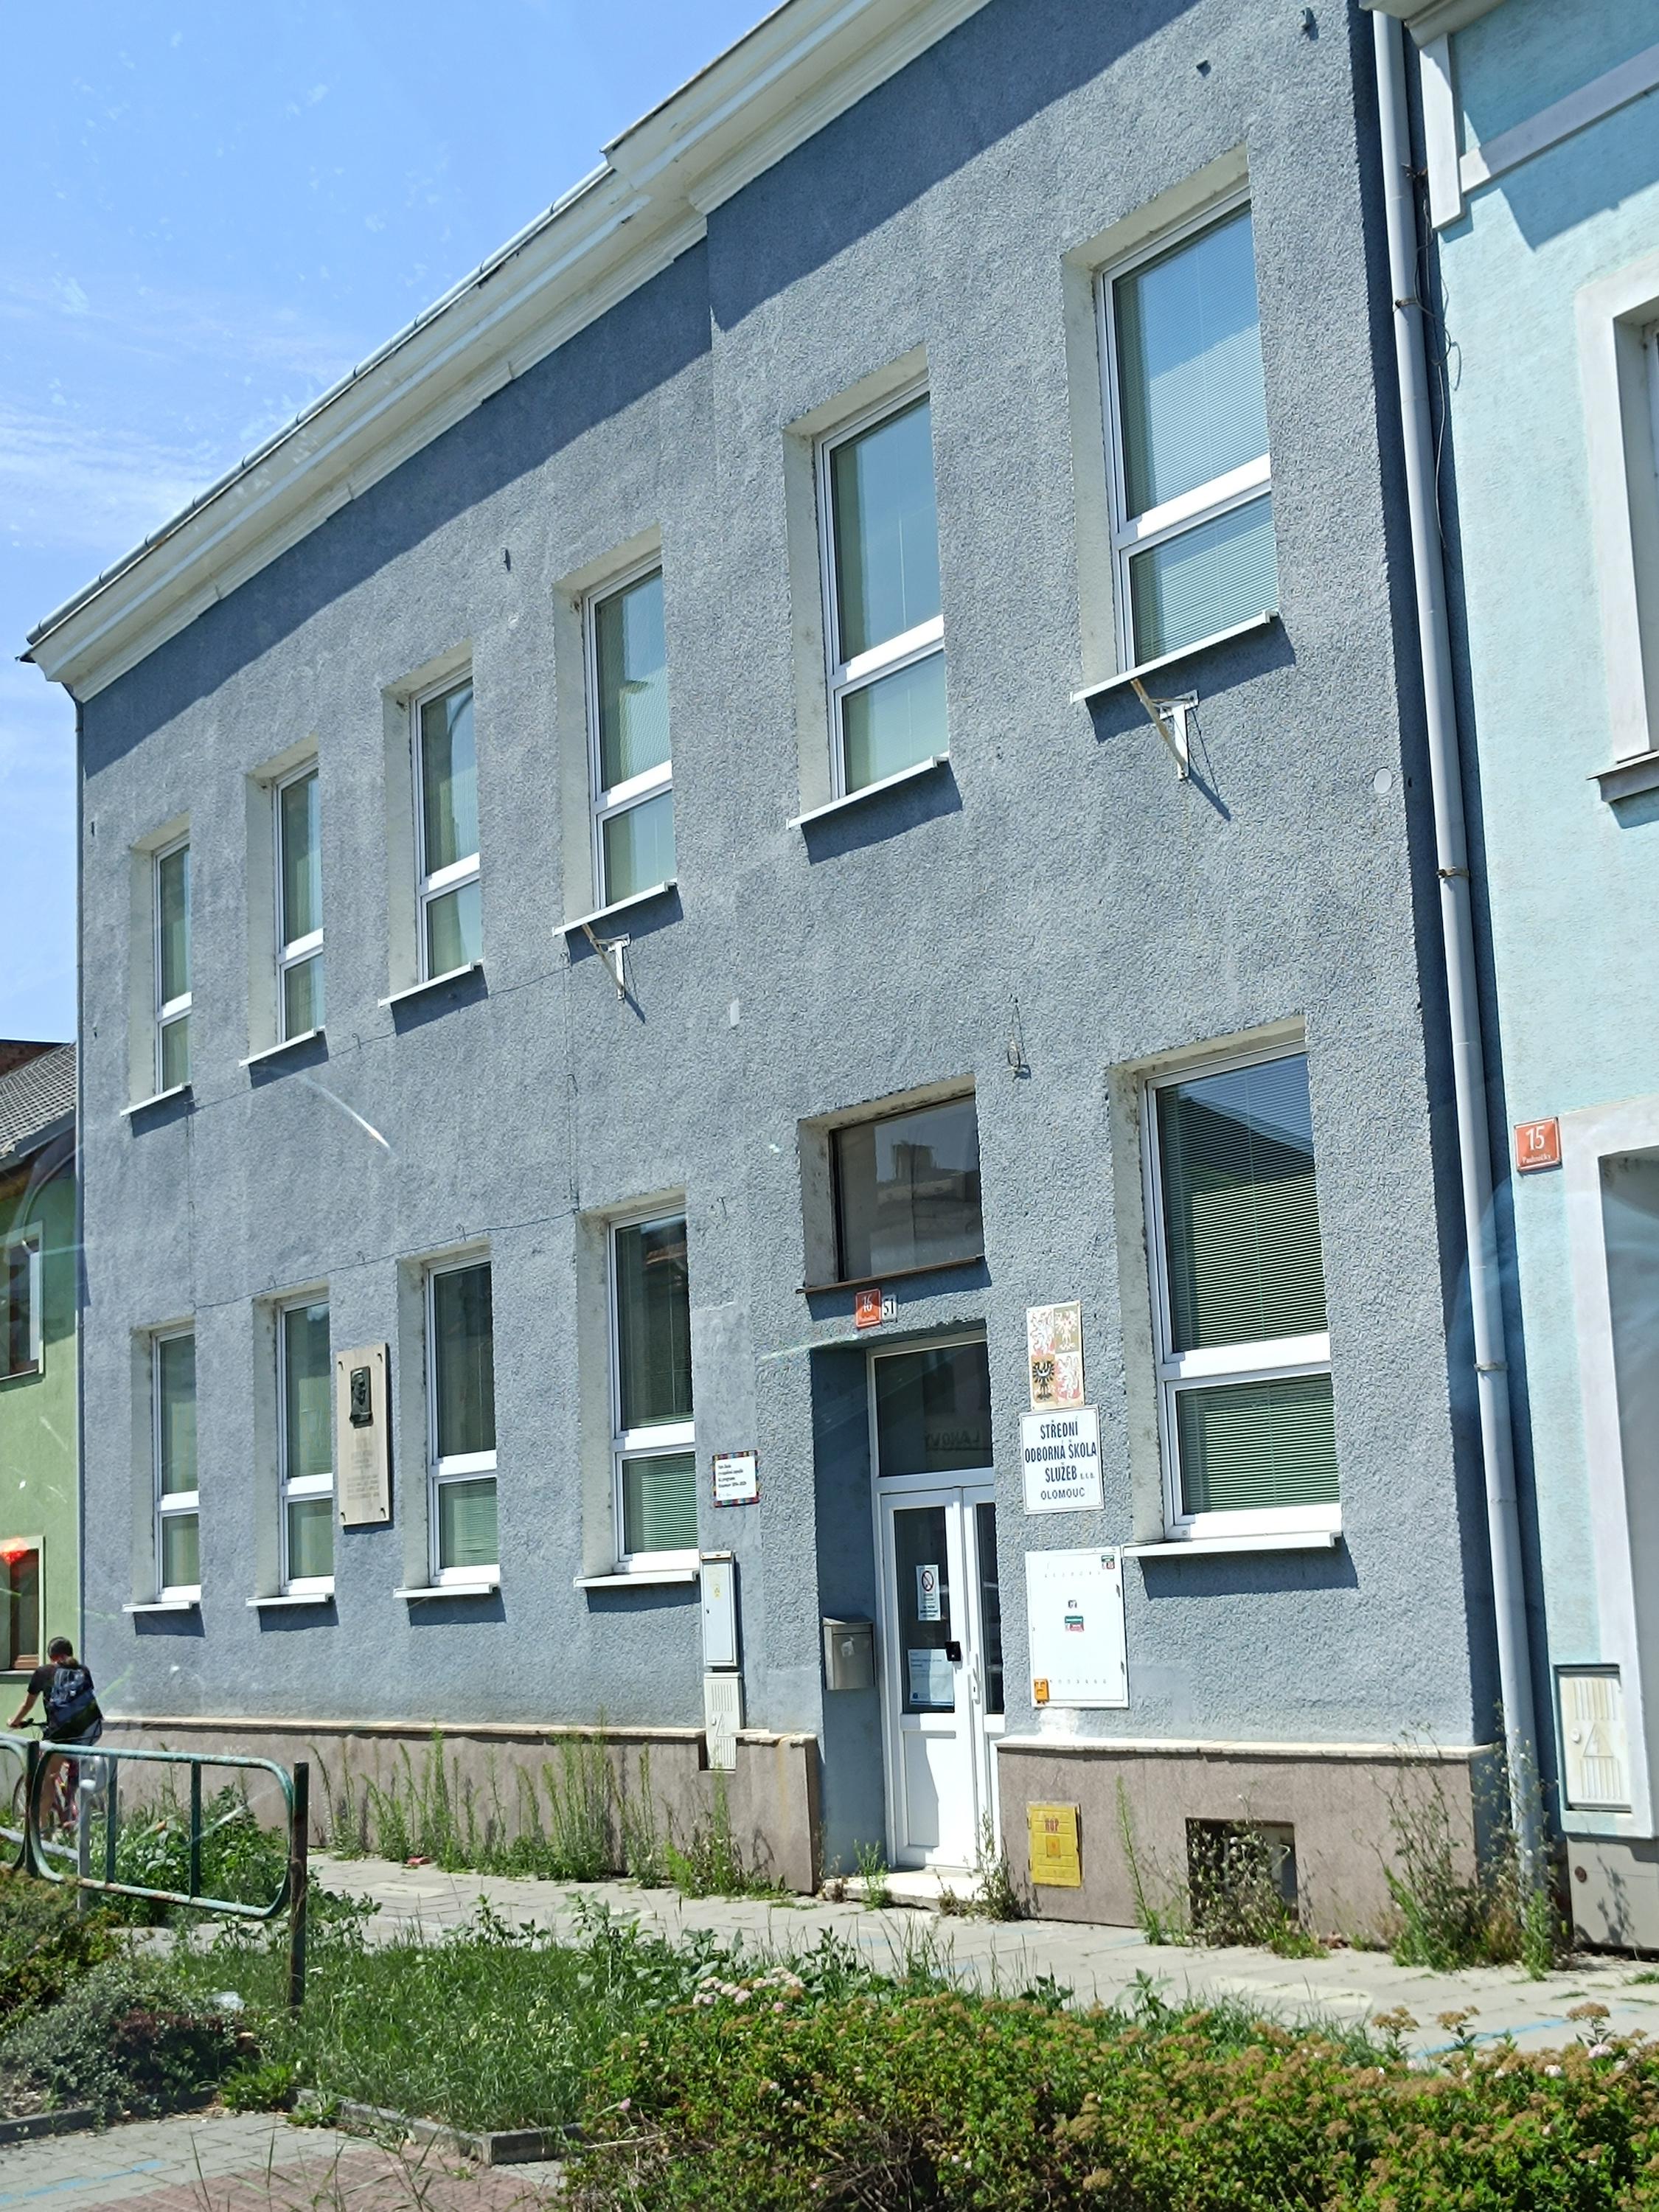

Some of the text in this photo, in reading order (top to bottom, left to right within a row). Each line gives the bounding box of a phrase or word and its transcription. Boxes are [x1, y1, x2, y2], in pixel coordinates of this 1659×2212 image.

[1526, 1125, 1545, 1150] 15
[883, 1298, 894, 1315] 51
[1040, 1416, 1078, 1439] STŘEDNÍ
[1025, 1439, 1097, 1463] ODBORNÁ ŠKOLA
[1045, 1462, 1077, 1483] SLUŽEB
[1040, 1487, 1085, 1500] OLOMOUC
